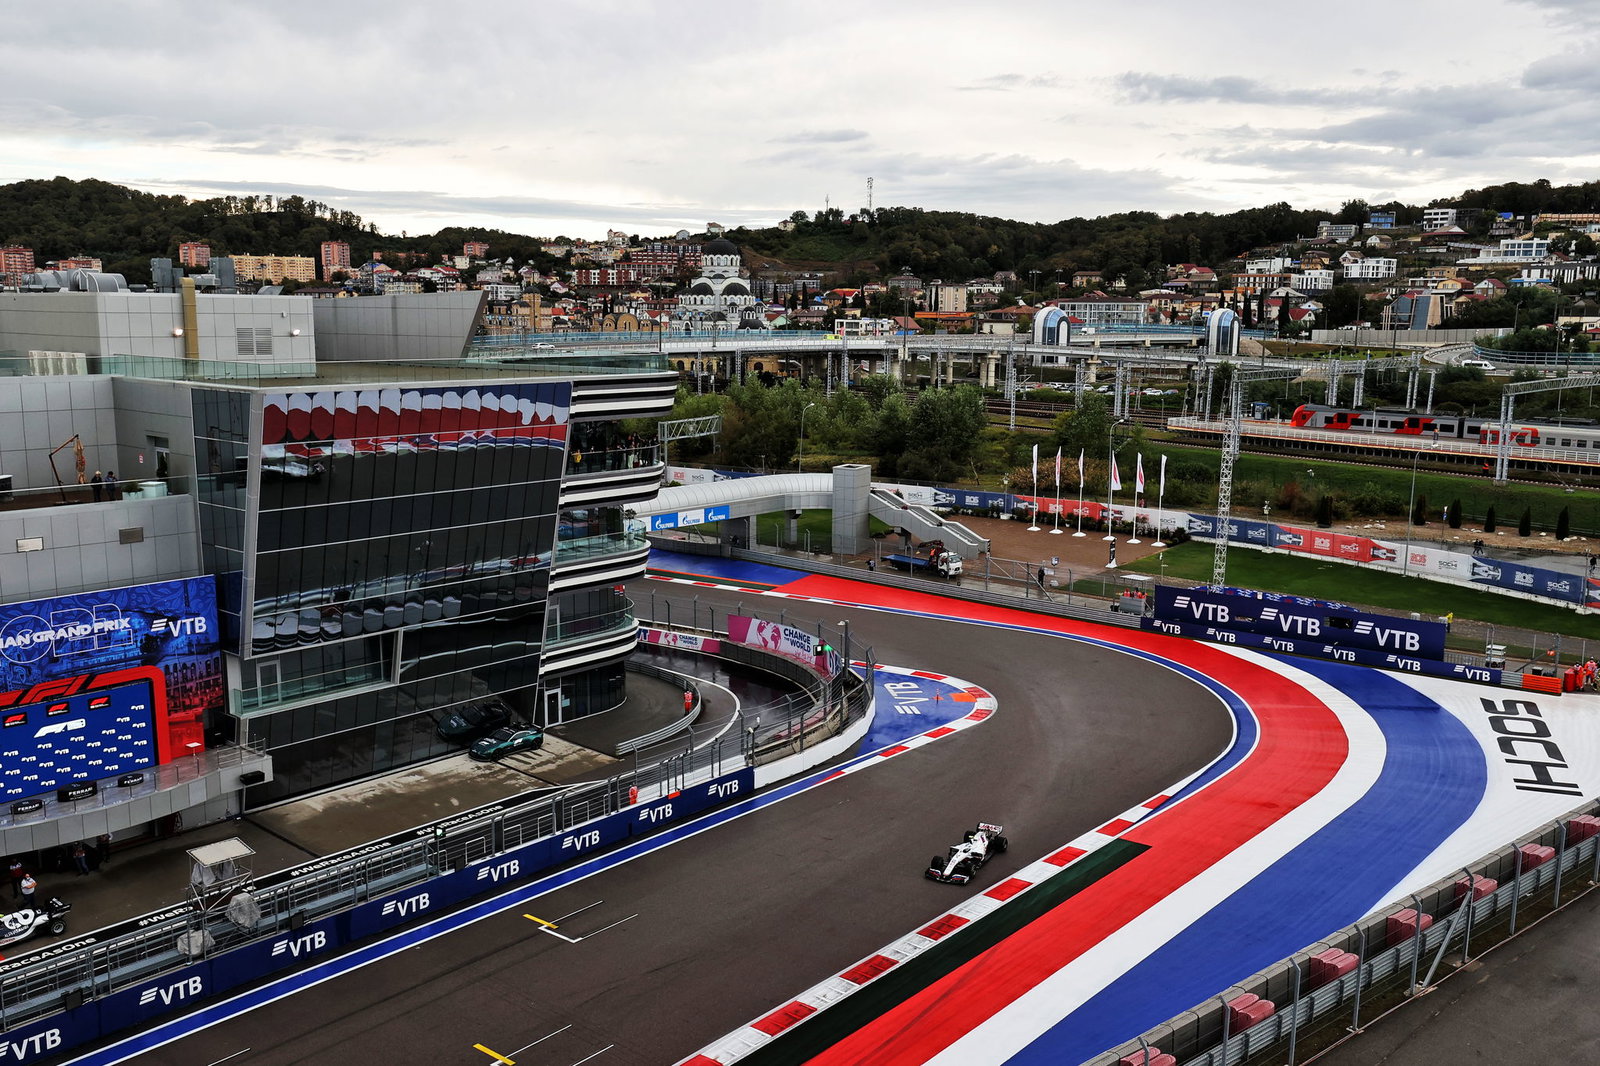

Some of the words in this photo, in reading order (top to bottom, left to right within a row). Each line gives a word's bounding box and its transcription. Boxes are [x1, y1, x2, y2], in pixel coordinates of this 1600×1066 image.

[1547, 581, 1570, 590] SOCHI
[1191, 602, 1229, 623] VTB
[33, 624, 93, 643] GRAND
[93, 617, 130, 634] PRIX
[169, 616, 207, 637] VTB
[1162, 623, 1181, 635] VTB
[1279, 613, 1320, 636] VTB
[679, 634, 698, 642] CHANGE
[783, 628, 811, 645] CHANGE
[789, 638, 811, 653] WORLD
[1215, 632, 1236, 643] VTB
[1273, 639, 1294, 652] VTB
[1374, 627, 1420, 652] VTB
[1333, 648, 1356, 662] VTB
[1397, 659, 1421, 671] VTB
[1465, 668, 1491, 682] VTB
[884, 682, 929, 704] VTB
[1480, 697, 1583, 797] SOCHI
[68, 786, 93, 796] FERRARI
[717, 779, 739, 797] VTB
[17, 803, 40, 811] FERRARI
[649, 804, 673, 823] VTB
[574, 830, 600, 850] VTB
[290, 842, 391, 877] #WeRaceAsOne
[490, 859, 520, 881] VTB
[396, 893, 430, 917] VTB
[289, 931, 326, 957] VTB
[160, 976, 203, 1005] VTB
[12, 1028, 62, 1060] VTB
